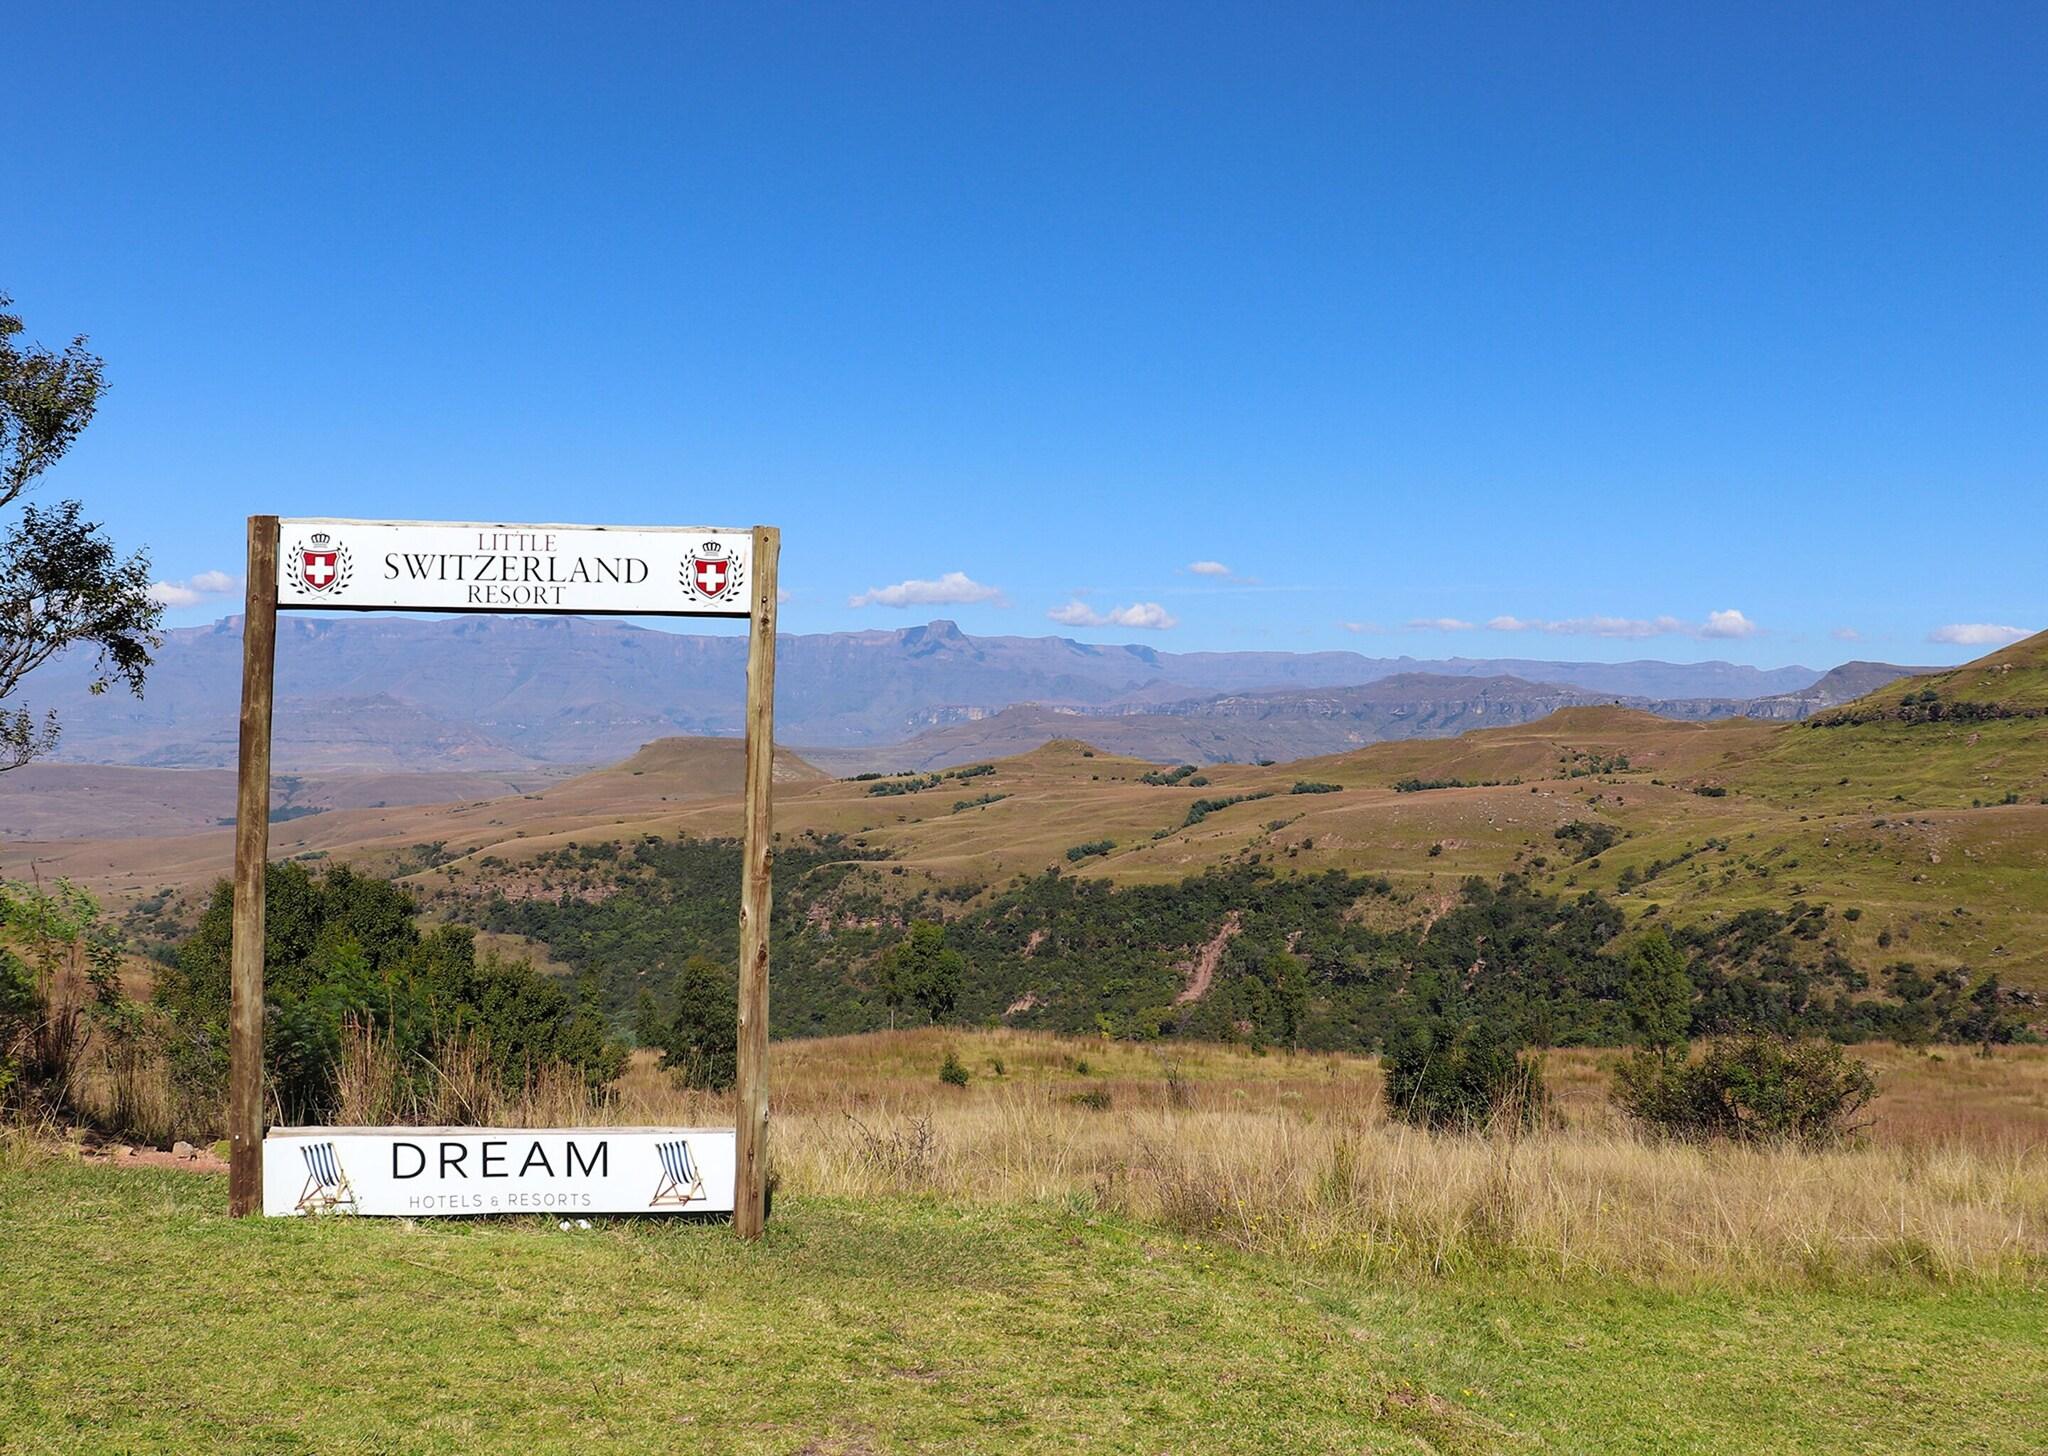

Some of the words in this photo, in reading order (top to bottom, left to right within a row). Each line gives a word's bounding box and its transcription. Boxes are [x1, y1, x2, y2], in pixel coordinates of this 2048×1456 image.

[477, 533, 557, 552] LITTLE
[384, 552, 649, 585] SWITZERLAND
[467, 584, 567, 605] RESORT
[392, 1141, 609, 1179] DREAM
[409, 1194, 483, 1208] HOTELS
[491, 1197, 499, 1208] &
[508, 1193, 592, 1208] RESORTS
